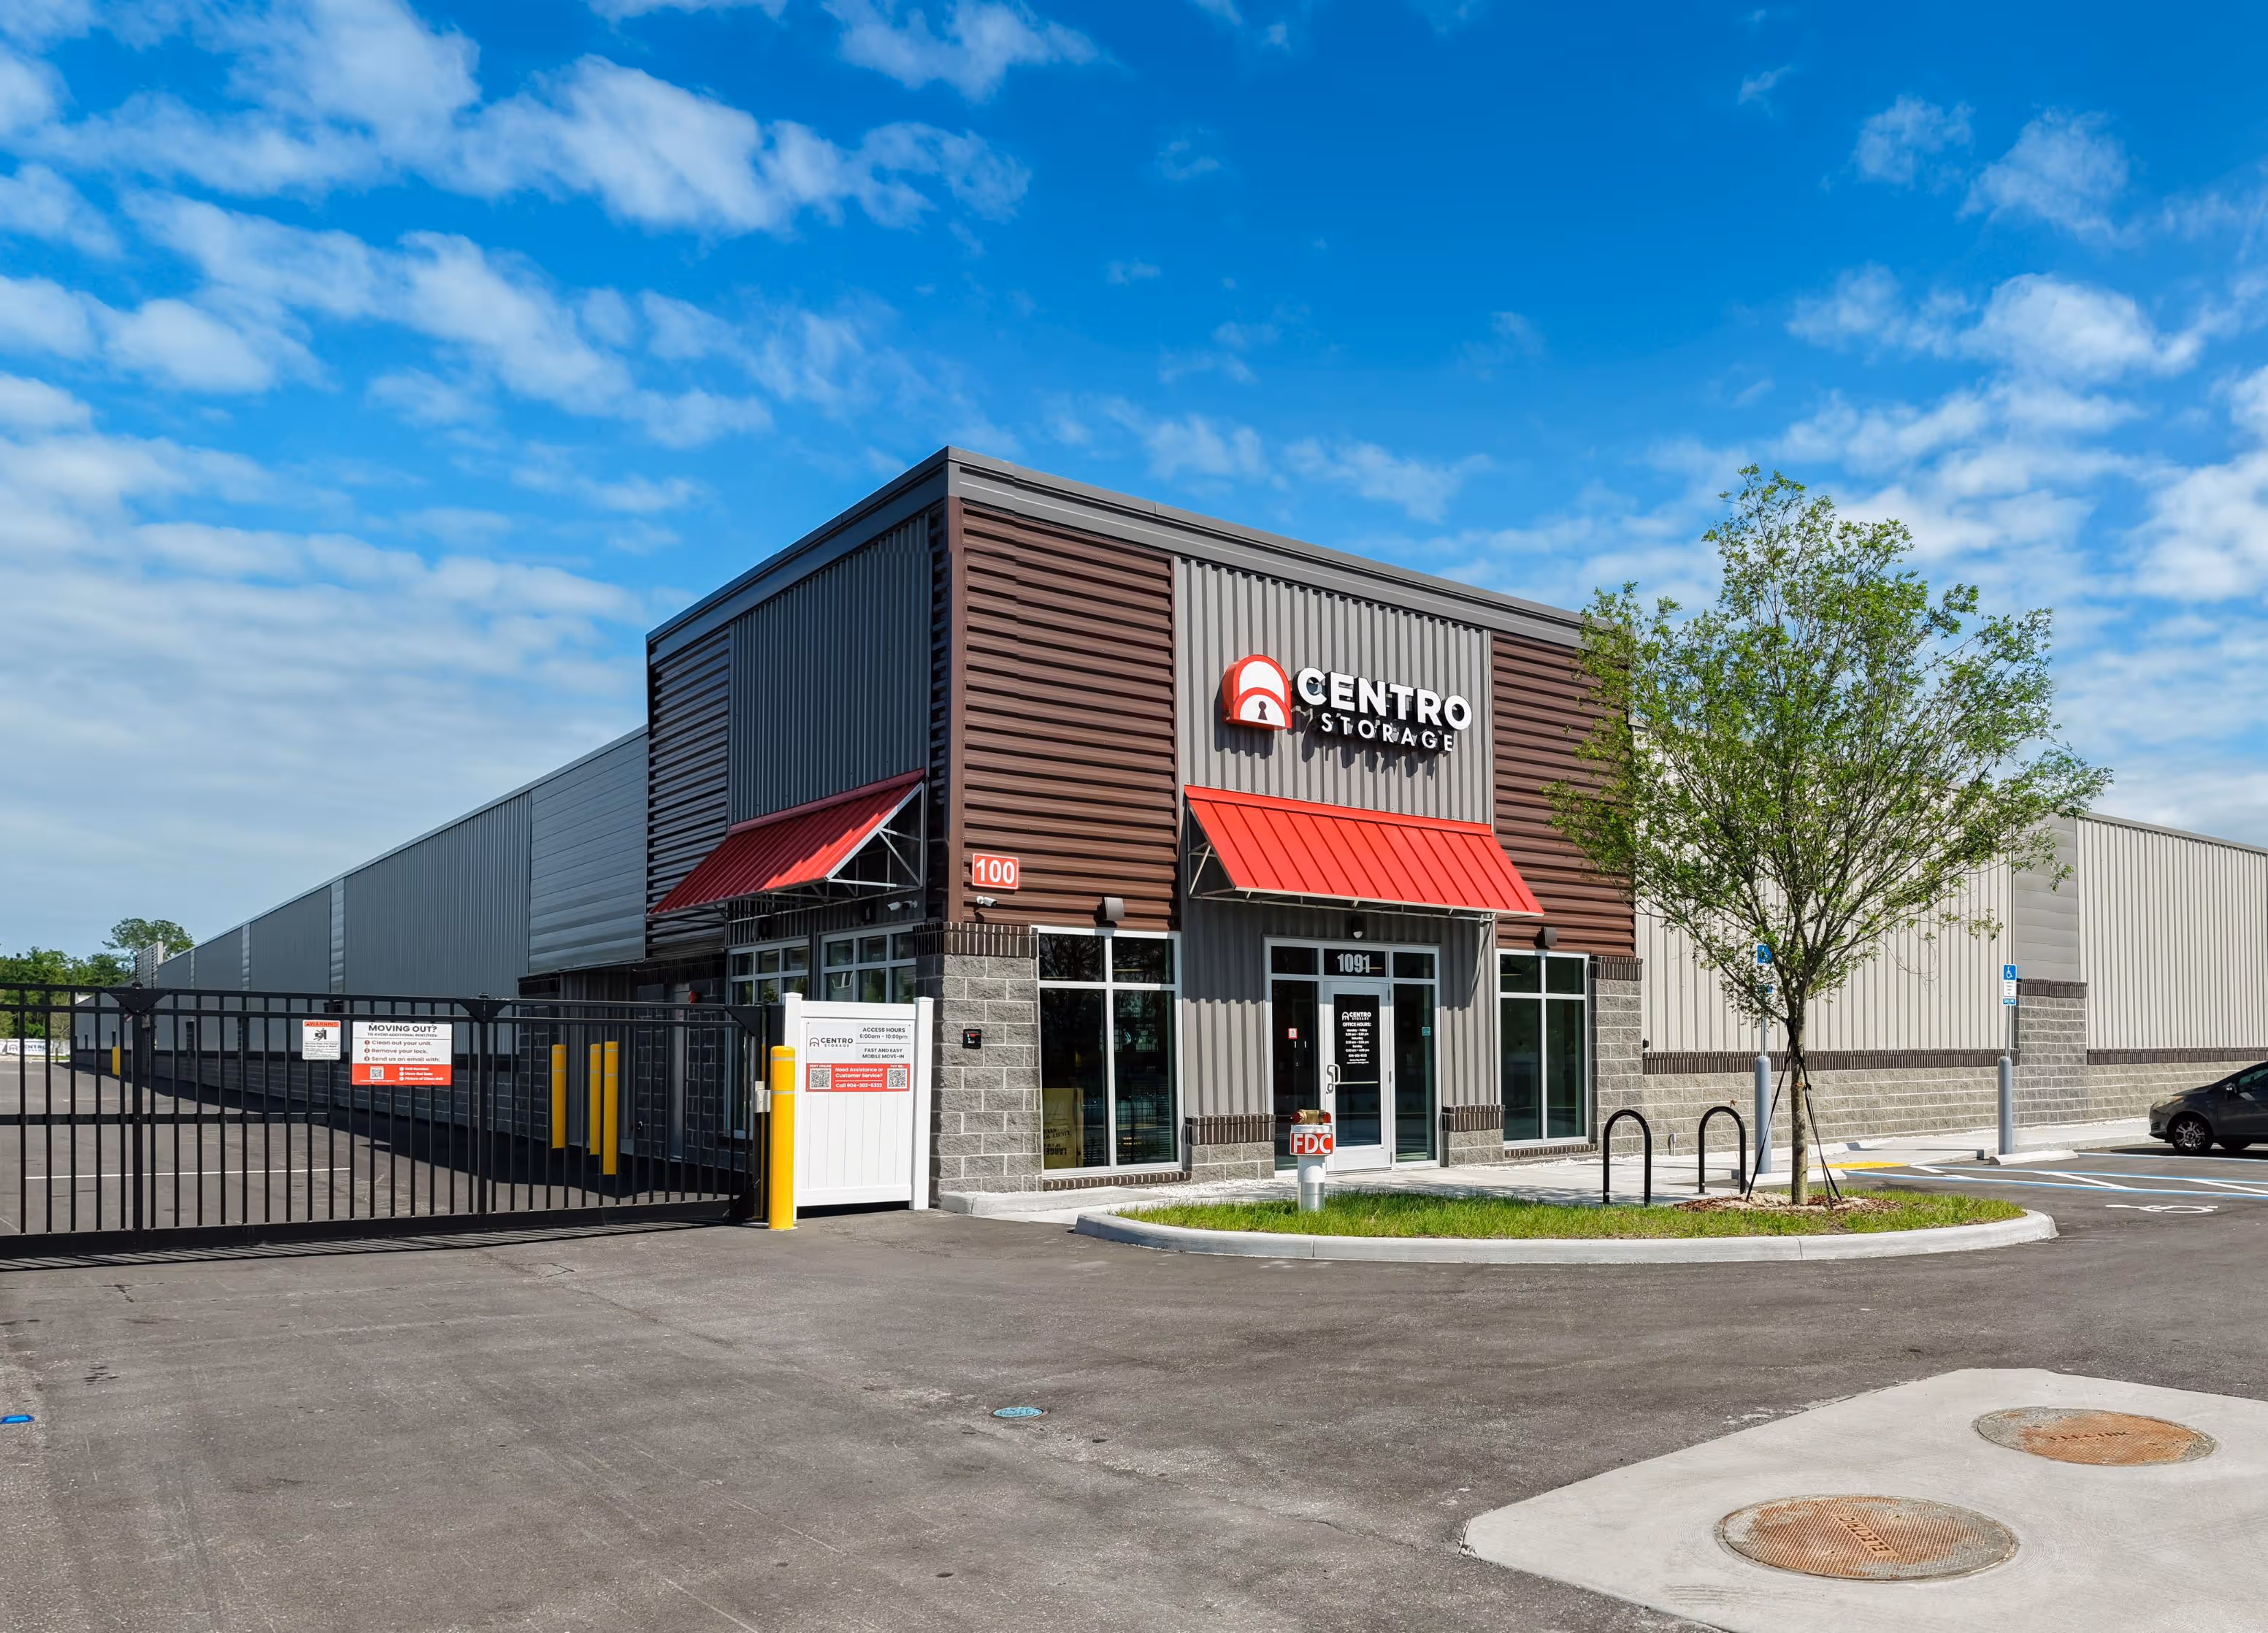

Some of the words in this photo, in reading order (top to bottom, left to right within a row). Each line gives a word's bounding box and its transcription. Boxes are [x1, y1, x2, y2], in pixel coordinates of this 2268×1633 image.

[1295, 666, 1473, 730] CENTRO
[1320, 711, 1453, 752] STORAGE
[976, 858, 1015, 884] 100
[1337, 953, 1370, 974] 1091
[1046, 1147, 1067, 1155] LARGE
[1293, 1133, 1331, 1154] FDC
[2049, 1431, 2136, 1441] ELECTRIC
[1839, 1516, 1891, 1553] ELECTRIC
